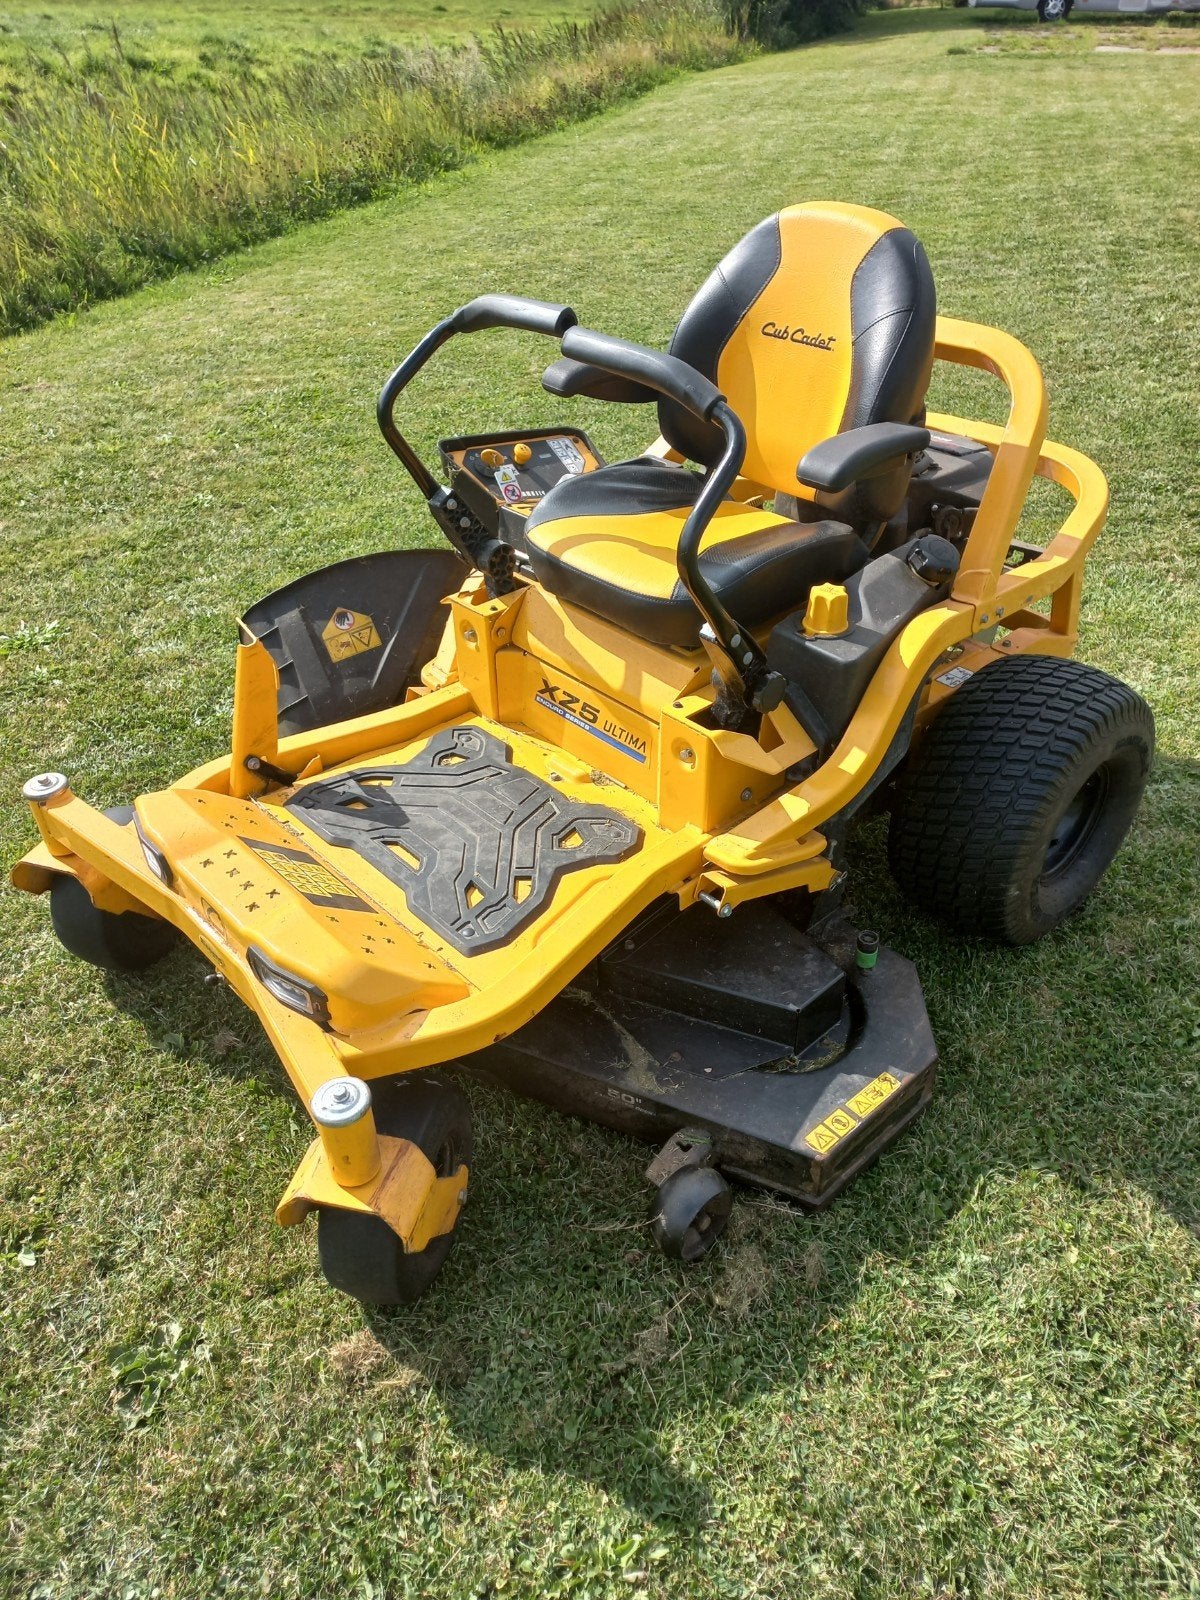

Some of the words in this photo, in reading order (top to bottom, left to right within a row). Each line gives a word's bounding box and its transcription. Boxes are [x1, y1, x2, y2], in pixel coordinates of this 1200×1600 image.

[761, 322, 790, 340] Cub
[790, 328, 836, 351] Cadet
[536, 696, 564, 715] ENDURO
[565, 712, 591, 731] SERIES
[537, 678, 601, 724] XZ5
[603, 720, 647, 753] ULTIMA
